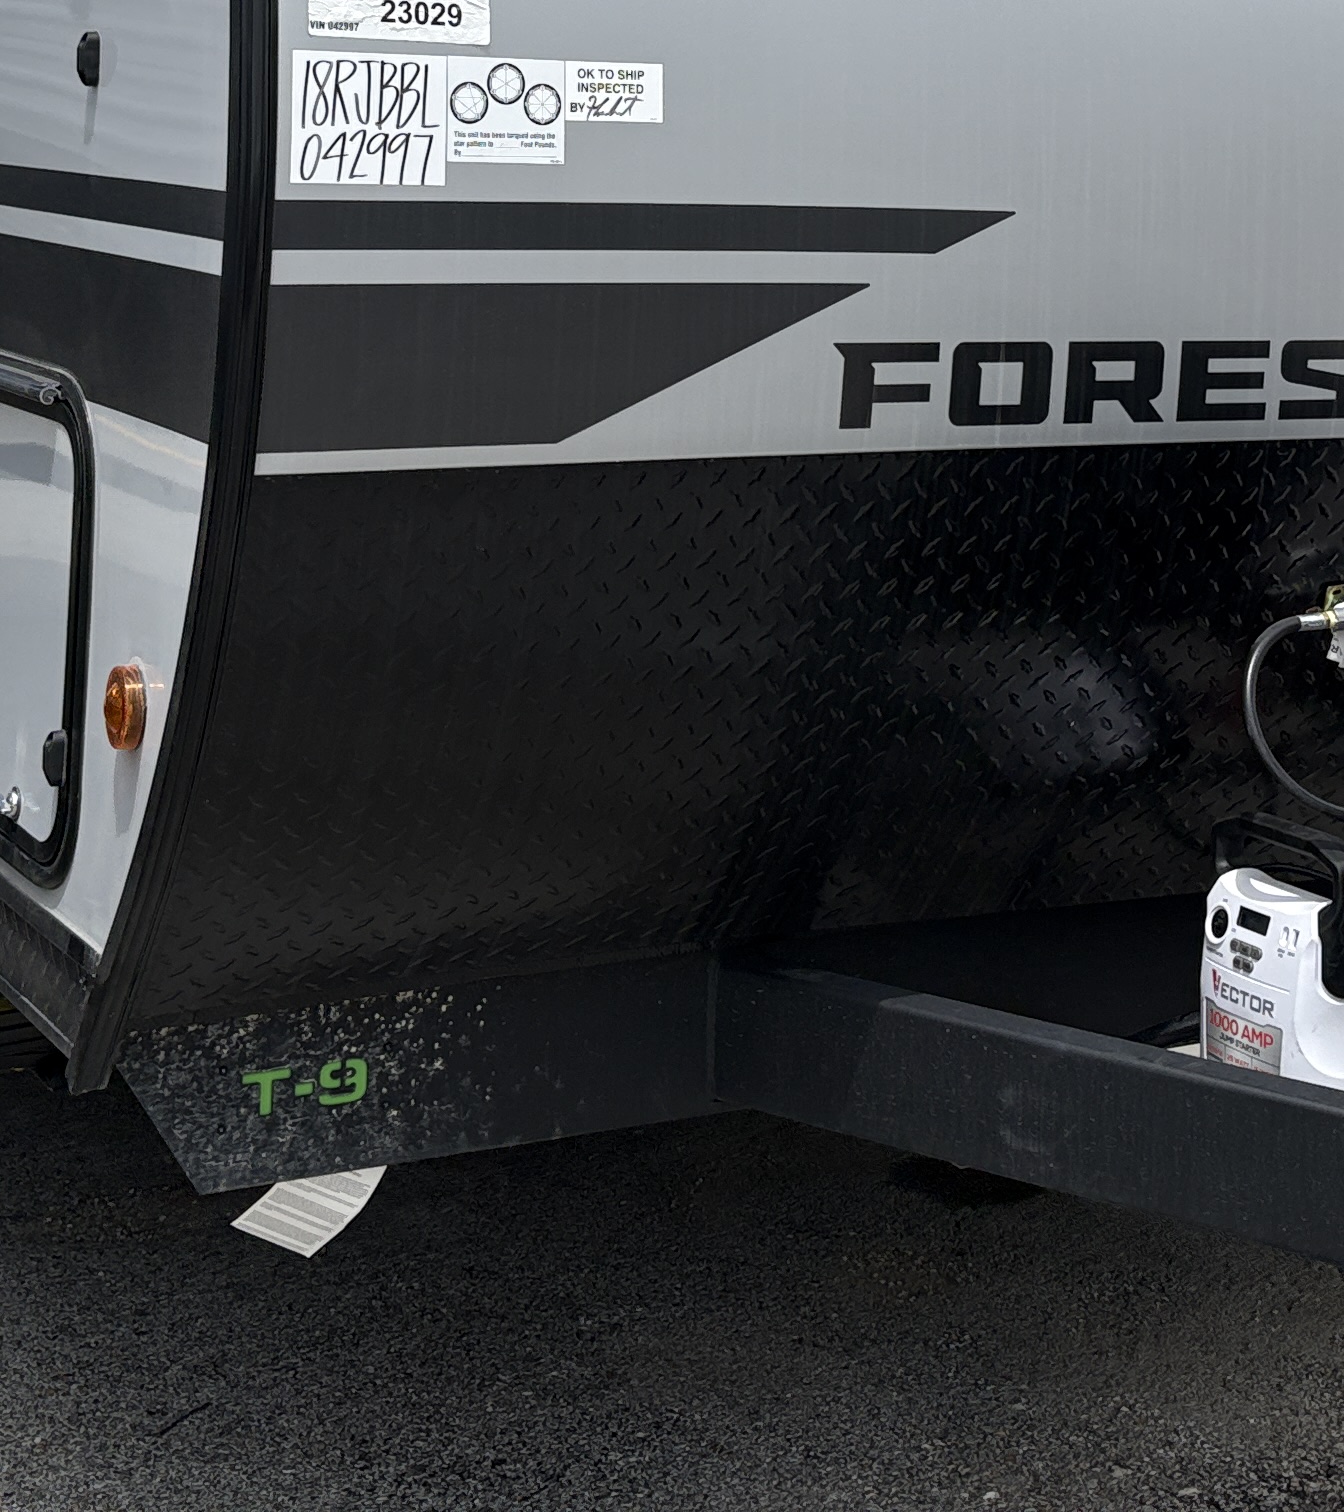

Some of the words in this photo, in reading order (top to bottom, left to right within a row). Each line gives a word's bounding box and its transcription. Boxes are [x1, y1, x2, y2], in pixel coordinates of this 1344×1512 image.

[380, 0, 463, 27] 23029
[301, 59, 441, 130] 18RJBBL
[577, 69, 595, 79] OK
[599, 69, 614, 79] TO
[618, 70, 645, 80] SHIP
[577, 82, 644, 94] INSPECTED
[570, 102, 585, 113] BY
[299, 129, 434, 185] 042997
[1212, 968, 1275, 1019] VECTOR
[1209, 1008, 1239, 1036] 1000
[1241, 1025, 1274, 1048] AMP
[241, 1057, 369, 1117] T-9
